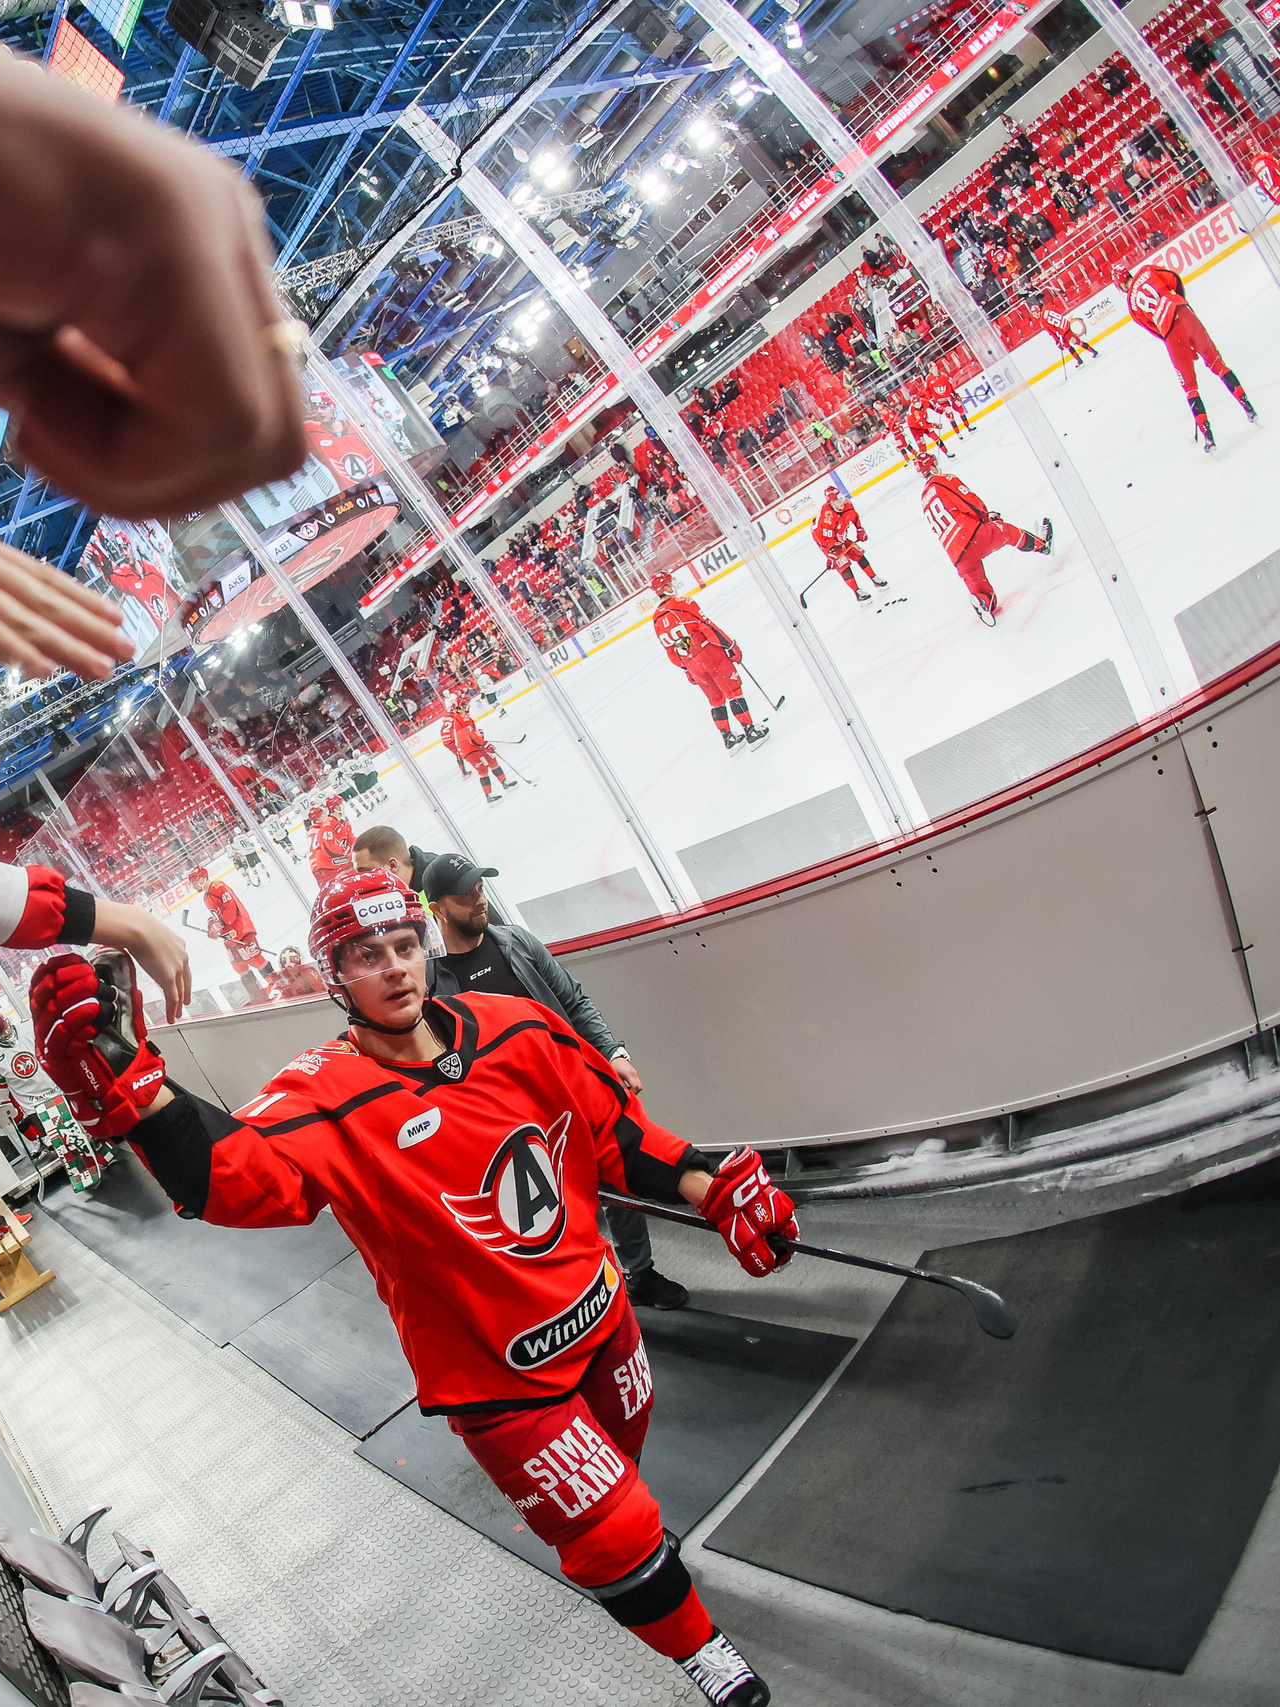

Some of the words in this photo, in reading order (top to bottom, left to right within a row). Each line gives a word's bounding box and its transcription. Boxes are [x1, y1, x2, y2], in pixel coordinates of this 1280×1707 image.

[959, 365, 1016, 414] Haier
[274, 539, 293, 557] АВТ
[228, 574, 246, 592] АКБ
[358, 899, 404, 919] согаз
[469, 966, 492, 981] CCM
[80, 1059, 100, 1091] TACKS
[132, 1069, 164, 1091] CCM
[406, 1120, 432, 1138] МИР
[750, 1252, 767, 1271] CCM
[523, 1284, 607, 1359] Winline
[621, 1369, 653, 1421] LAN
[523, 1415, 603, 1492] SIMA
[547, 1443, 626, 1519] LAND
